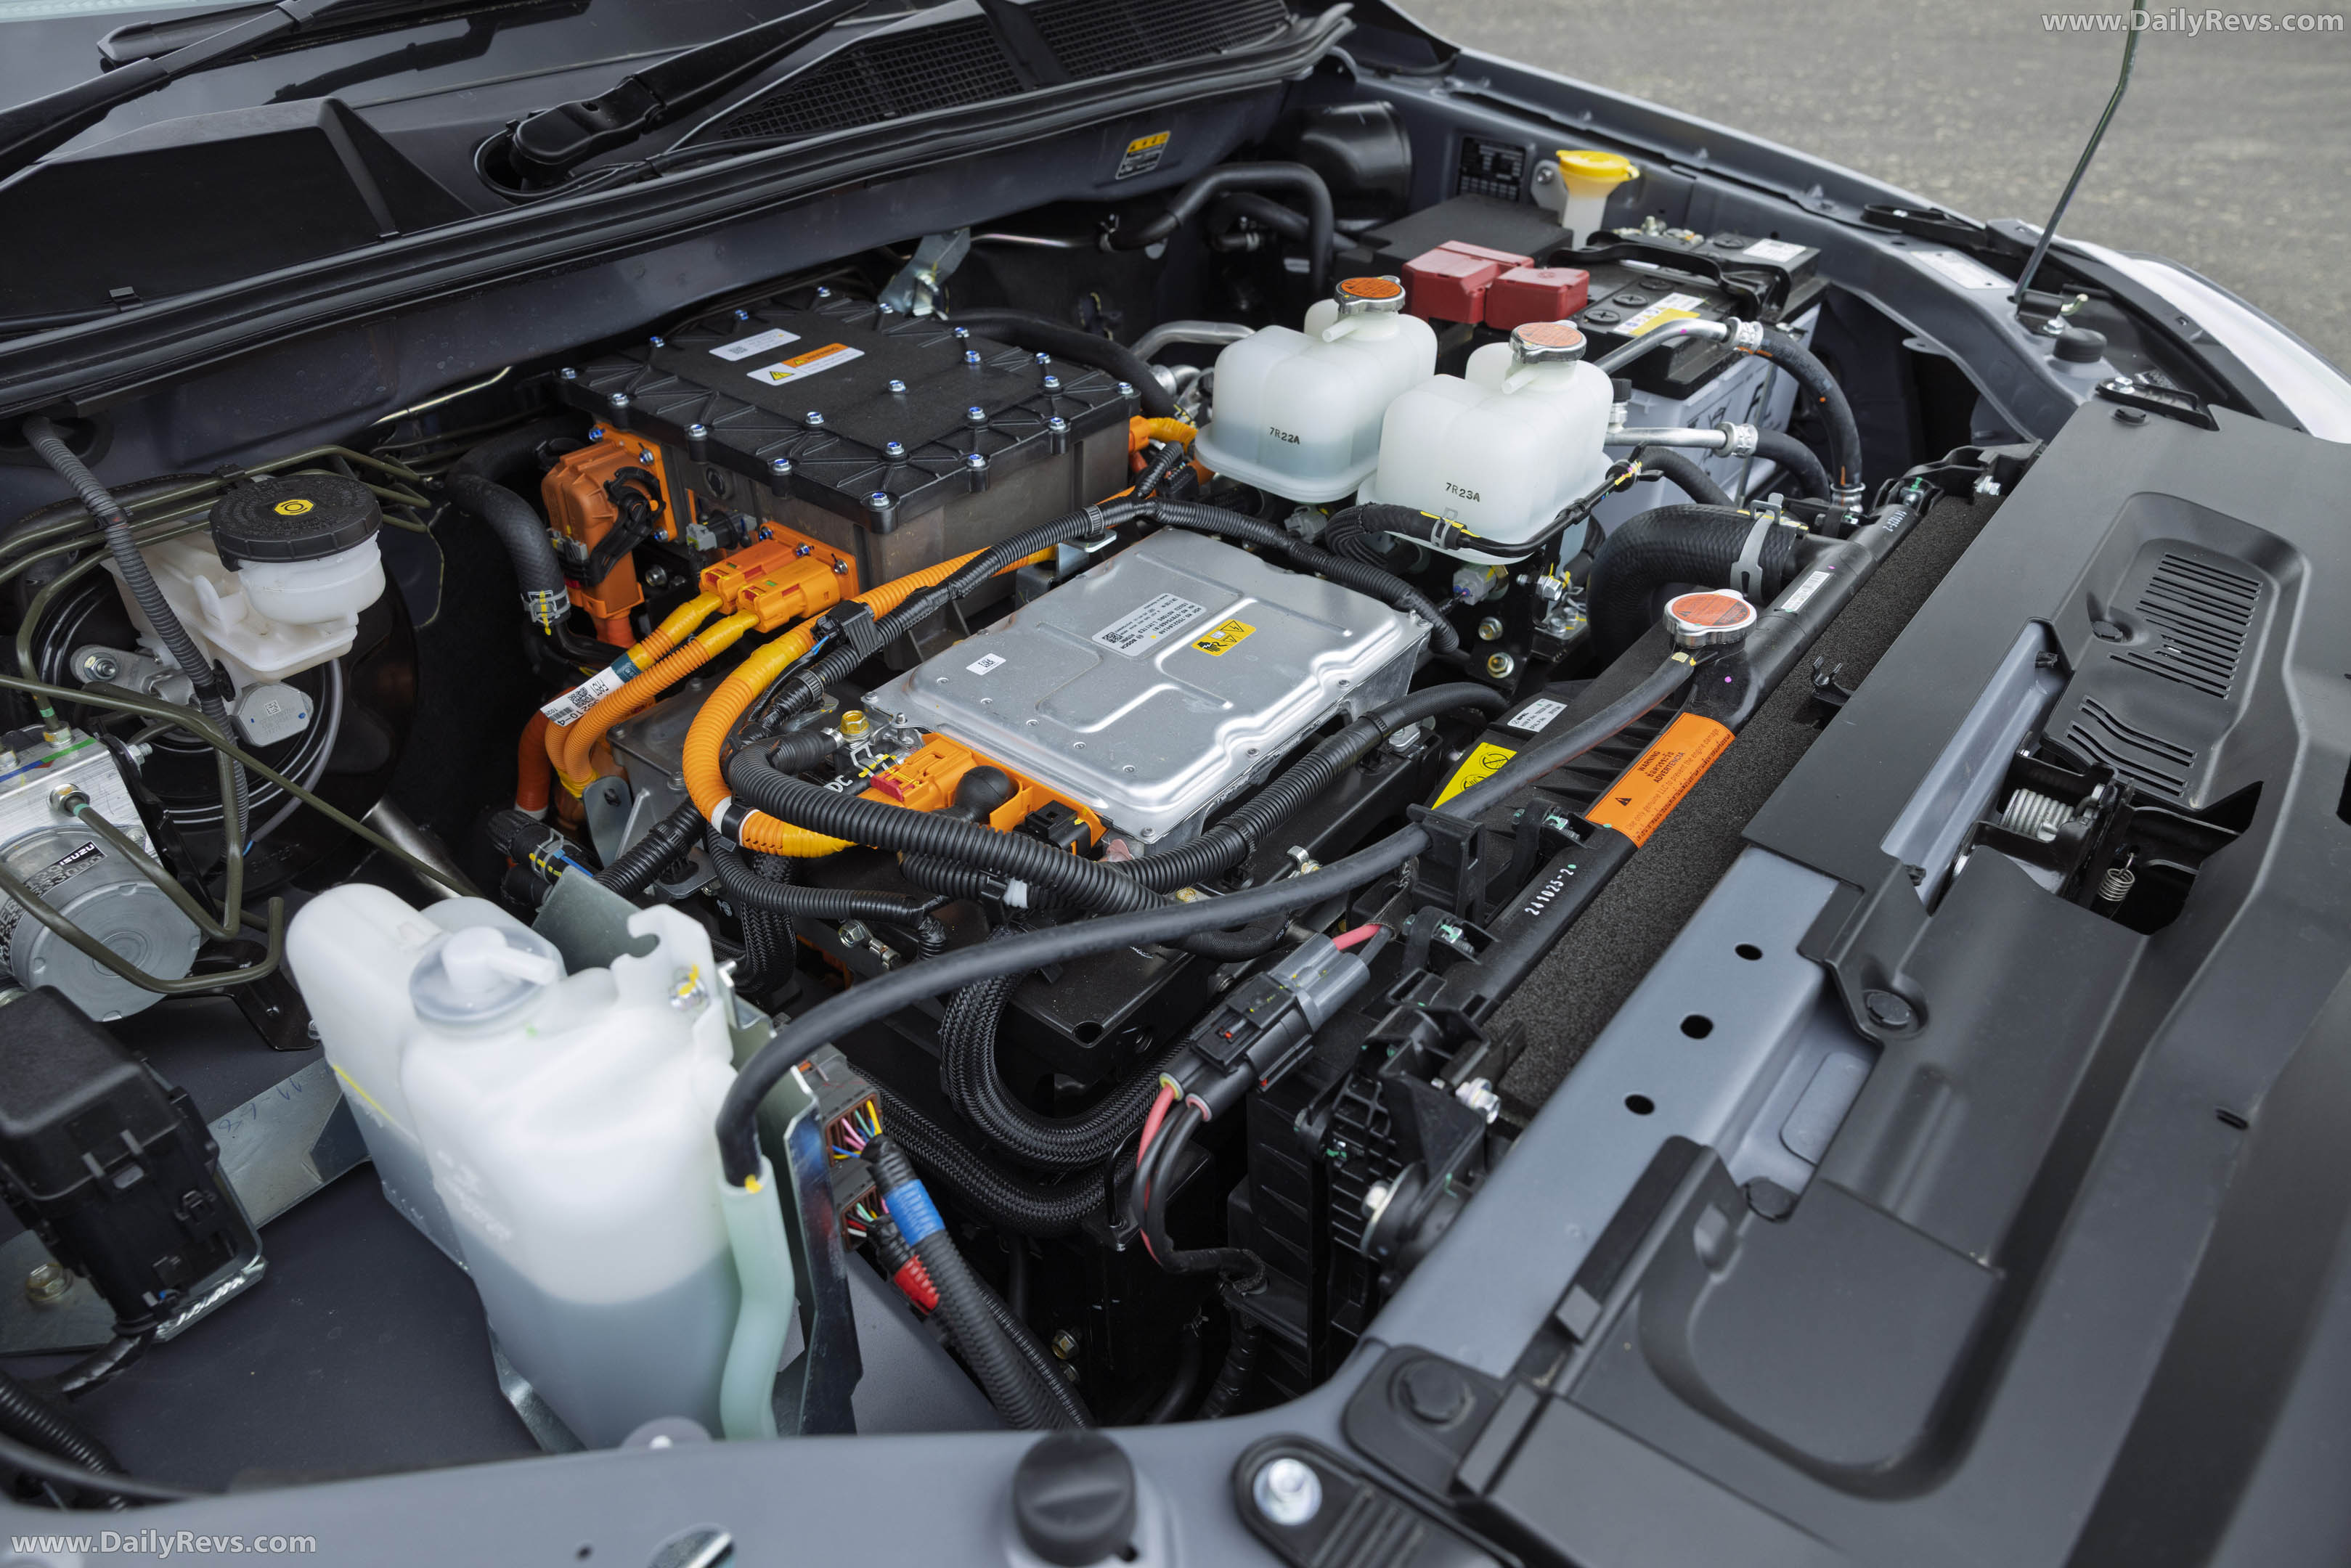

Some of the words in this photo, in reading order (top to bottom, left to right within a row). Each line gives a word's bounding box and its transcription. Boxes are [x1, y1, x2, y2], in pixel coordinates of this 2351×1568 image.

[1269, 427, 1300, 445] 7R22A
[1446, 482, 1480, 502] 7R23A
[1138, 621, 1158, 633] LIMITED
[1120, 639, 1138, 649] BOSCH
[590, 678, 609, 696] FAST
[1637, 750, 1661, 772] WARNING
[1653, 751, 1685, 784] ADVERTENCIA
[1643, 794, 1661, 813] genuine
[1659, 783, 1670, 797] LLC
[1671, 763, 1687, 783] prevent
[1692, 741, 1706, 758] engine
[60, 843, 95, 866] ISUZU
[1525, 868, 1574, 915] 241025-2
